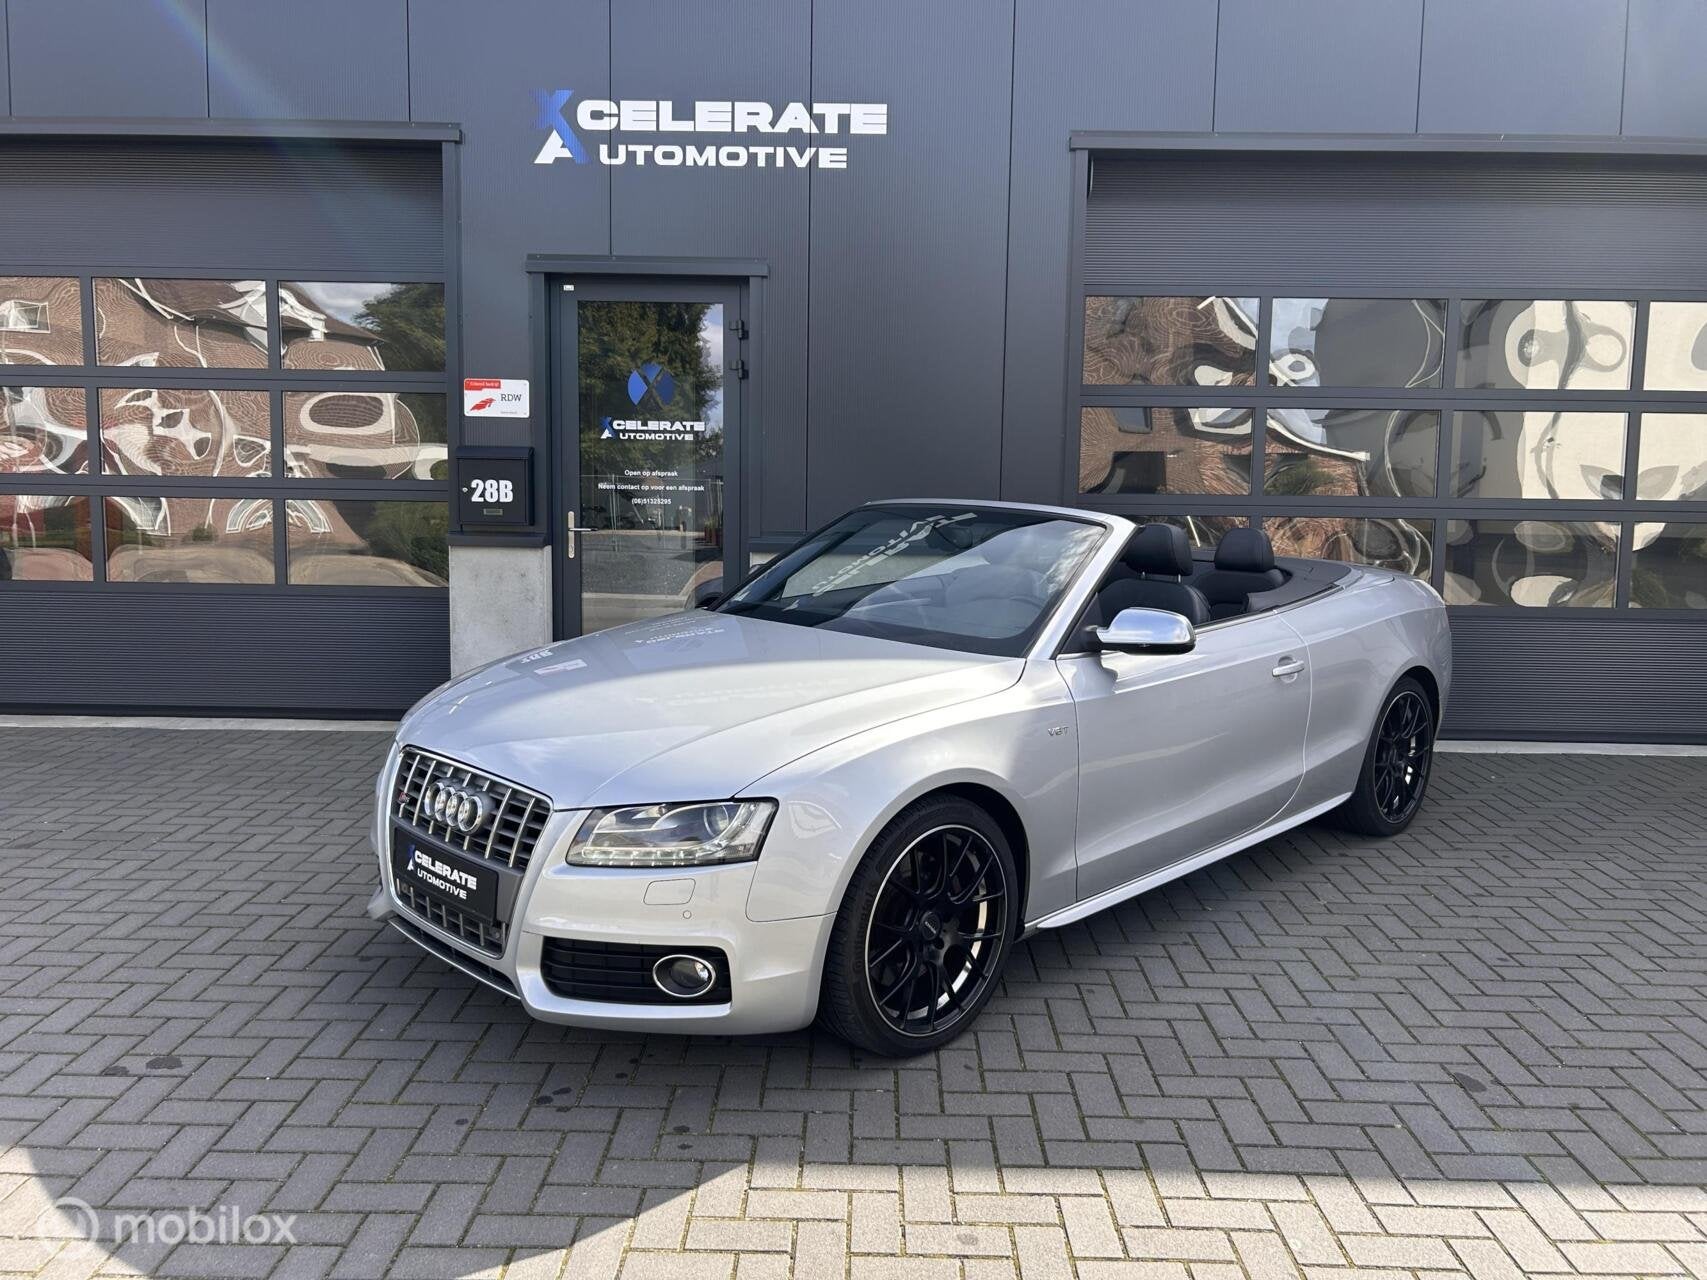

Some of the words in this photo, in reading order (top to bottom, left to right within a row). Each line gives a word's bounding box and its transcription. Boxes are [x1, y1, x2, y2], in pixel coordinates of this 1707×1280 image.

[500, 393, 522, 402] RDW
[624, 469, 641, 477] Open
[651, 469, 678, 477] afspraak
[470, 479, 514, 503] 28B
[617, 483, 640, 491] contact
[678, 484, 705, 493] afspraak
